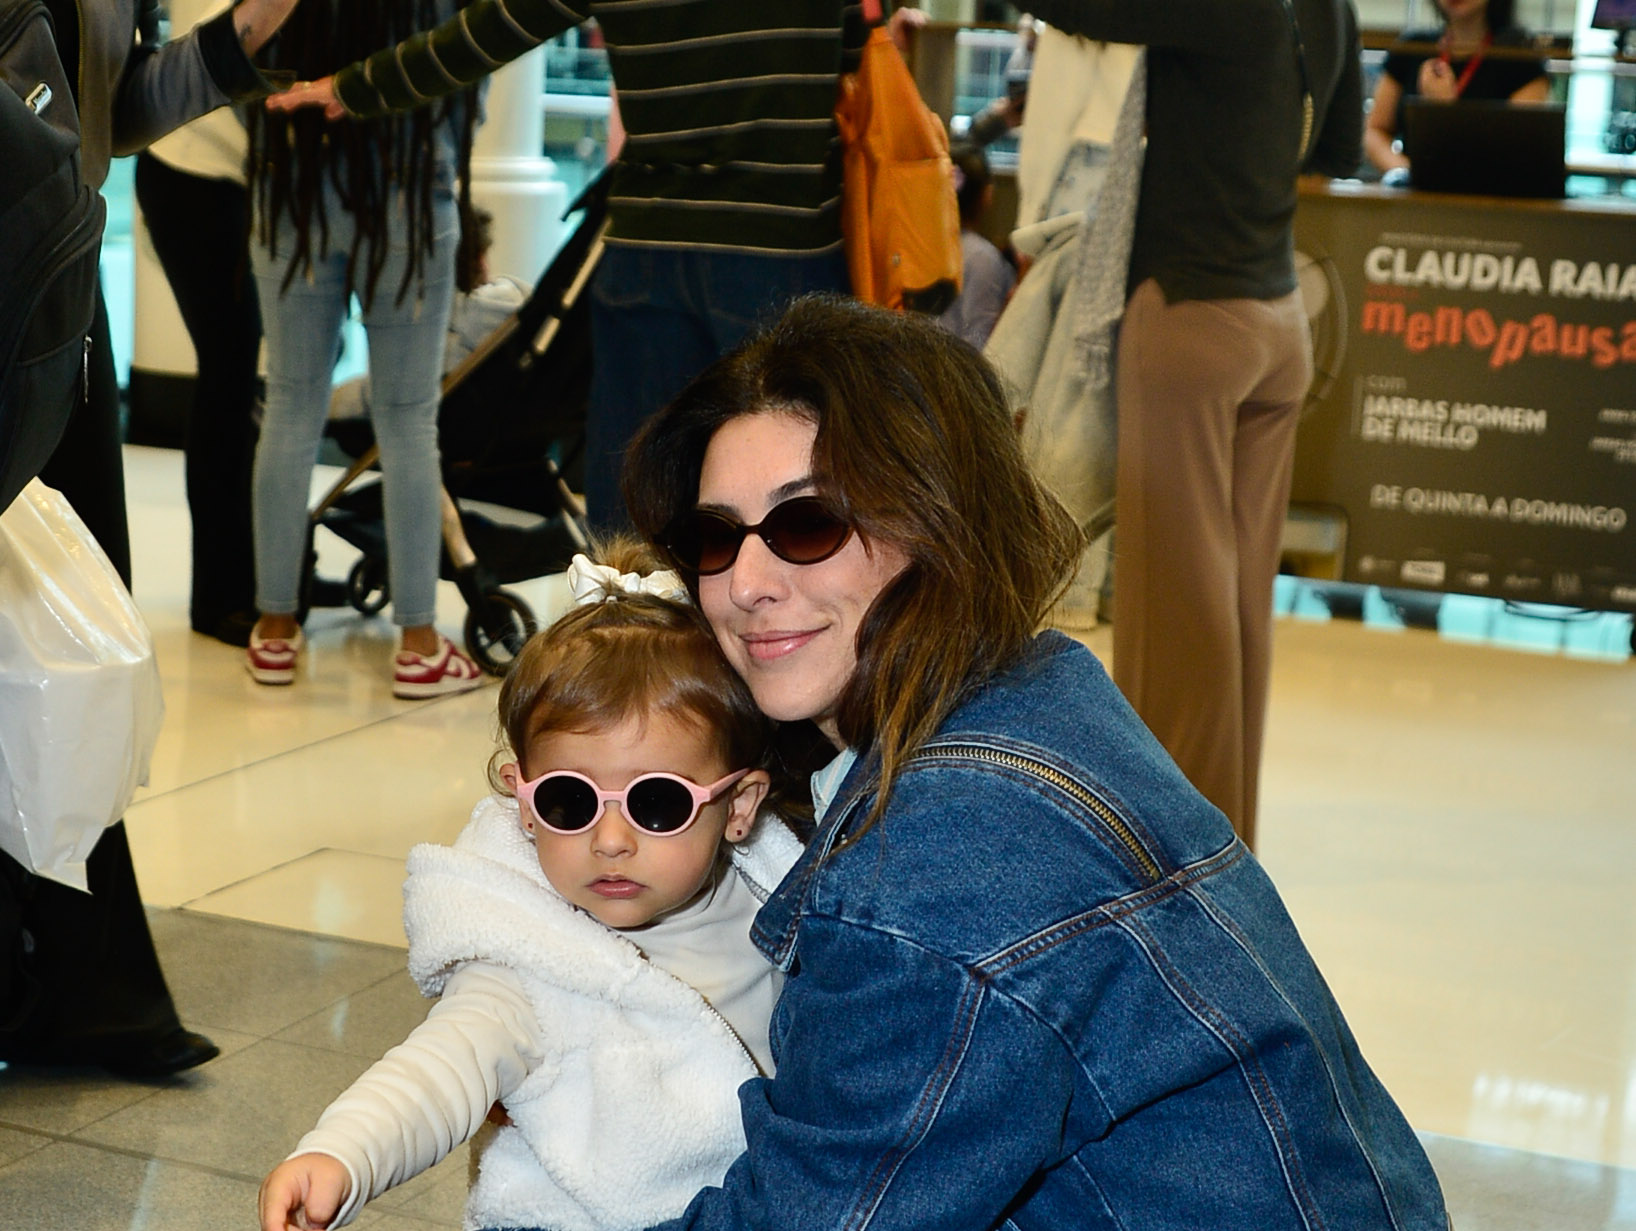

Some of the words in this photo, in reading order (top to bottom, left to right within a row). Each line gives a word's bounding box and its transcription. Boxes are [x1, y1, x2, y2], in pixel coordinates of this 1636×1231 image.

[1364, 246, 1542, 294] CLAUDIA
[1549, 258, 1636, 300] RAIA
[1361, 300, 1636, 369] menopausa
[1362, 415, 1395, 443] DE
[1396, 420, 1479, 450] MELLO
[1451, 402, 1547, 434] HOMEM
[1370, 483, 1402, 510] DE
[1403, 486, 1489, 517] QUINTA
[1489, 496, 1510, 520] A
[1510, 497, 1627, 534] DOMINGO
